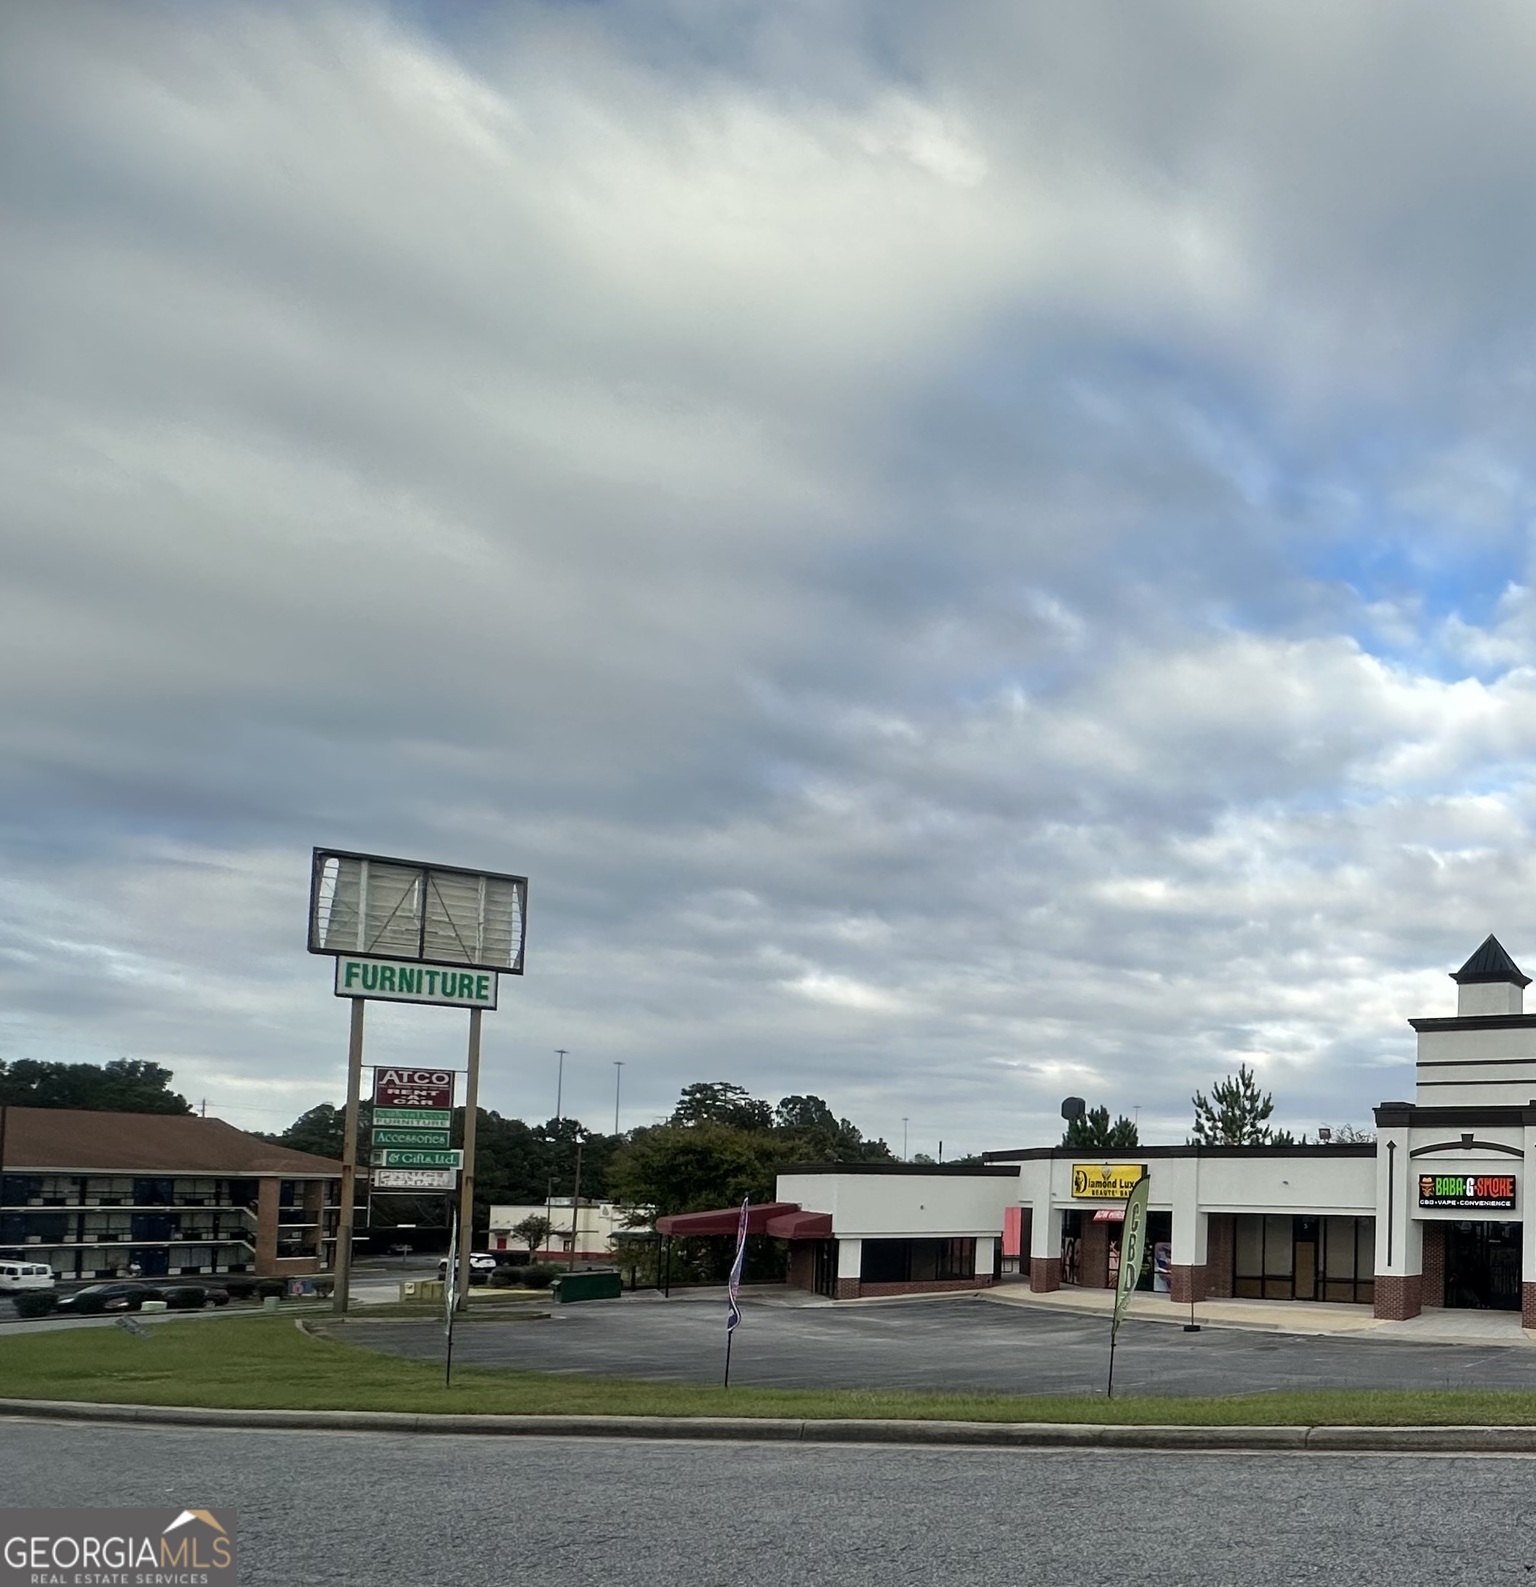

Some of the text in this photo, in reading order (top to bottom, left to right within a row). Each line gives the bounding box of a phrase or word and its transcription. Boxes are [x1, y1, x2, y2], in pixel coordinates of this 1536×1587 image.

[344, 961, 490, 1001] FURNITURE
[378, 1070, 450, 1086] ATCO
[387, 1088, 440, 1096] RENT
[393, 1098, 434, 1106] CAR
[375, 1118, 448, 1127] FURNITURE
[377, 1132, 446, 1144] Accessories
[388, 1153, 400, 1164] &
[435, 1154, 456, 1164] Ltd.
[1435, 1177, 1463, 1196] BABA
[1477, 1177, 1514, 1198] SMOKE
